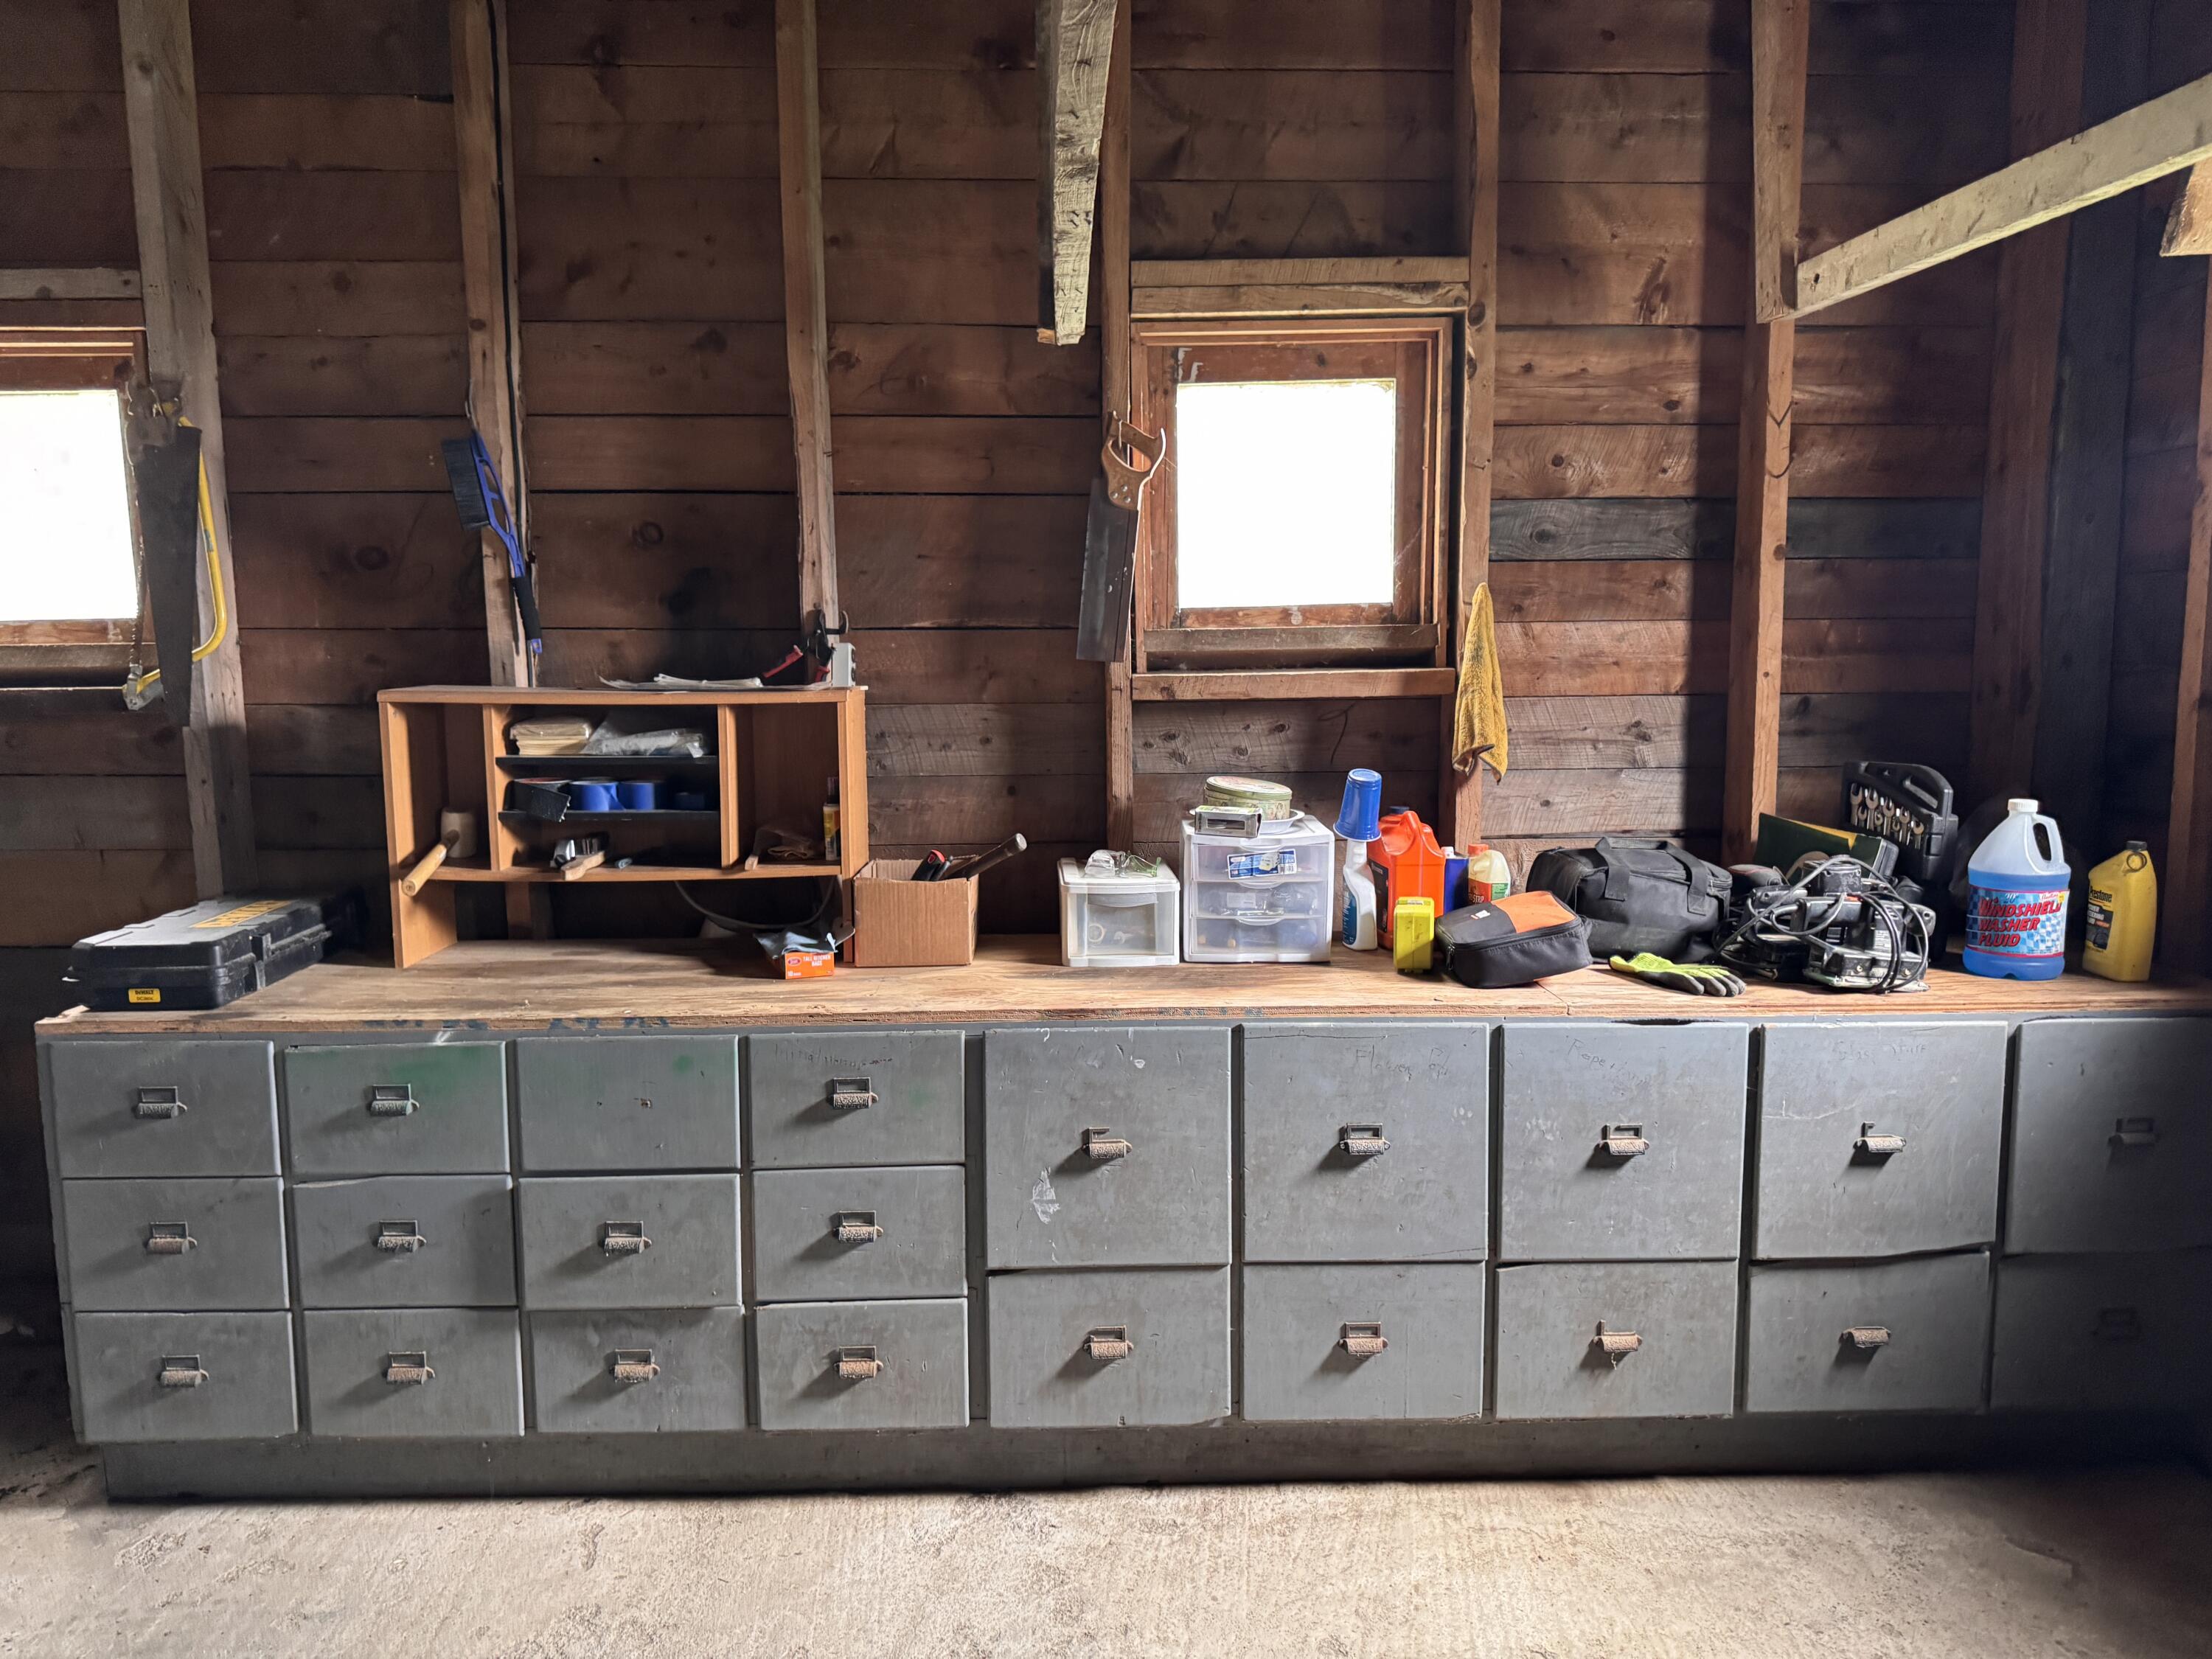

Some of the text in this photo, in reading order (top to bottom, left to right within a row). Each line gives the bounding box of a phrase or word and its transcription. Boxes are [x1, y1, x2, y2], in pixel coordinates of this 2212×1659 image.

[1979, 897, 2062, 917] WINDSHIELD
[1980, 917, 2040, 932] WASHER
[1979, 933, 2021, 947] FLUID
